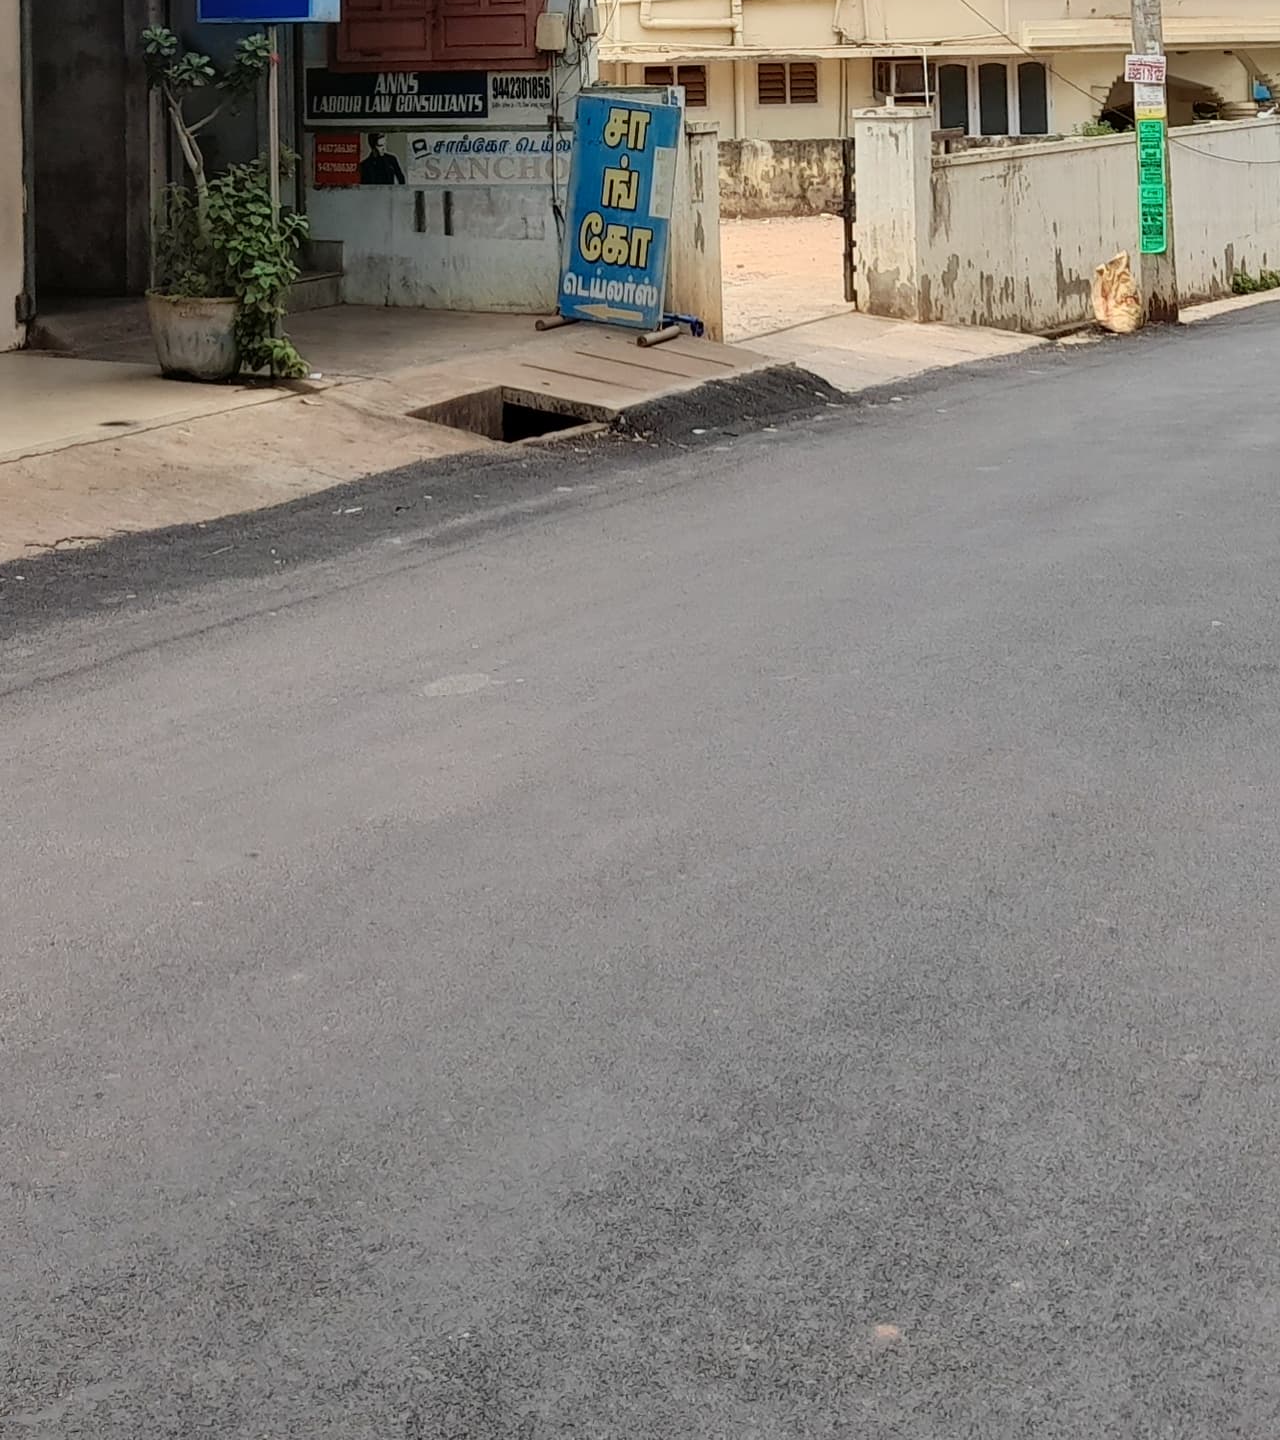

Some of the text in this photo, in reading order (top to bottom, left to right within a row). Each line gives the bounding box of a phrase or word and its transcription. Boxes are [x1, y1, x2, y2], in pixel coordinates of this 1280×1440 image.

[373, 71, 551, 100] ANNS 9442301856
[312, 95, 362, 113] LABOUR
[365, 95, 391, 113] LAW
[396, 94, 484, 113] CONSULTANTS
[432, 134, 509, 153] சாங்கோ
[424, 157, 568, 181] SANCHO
[562, 267, 659, 308] டெய்லர்ஸ்
